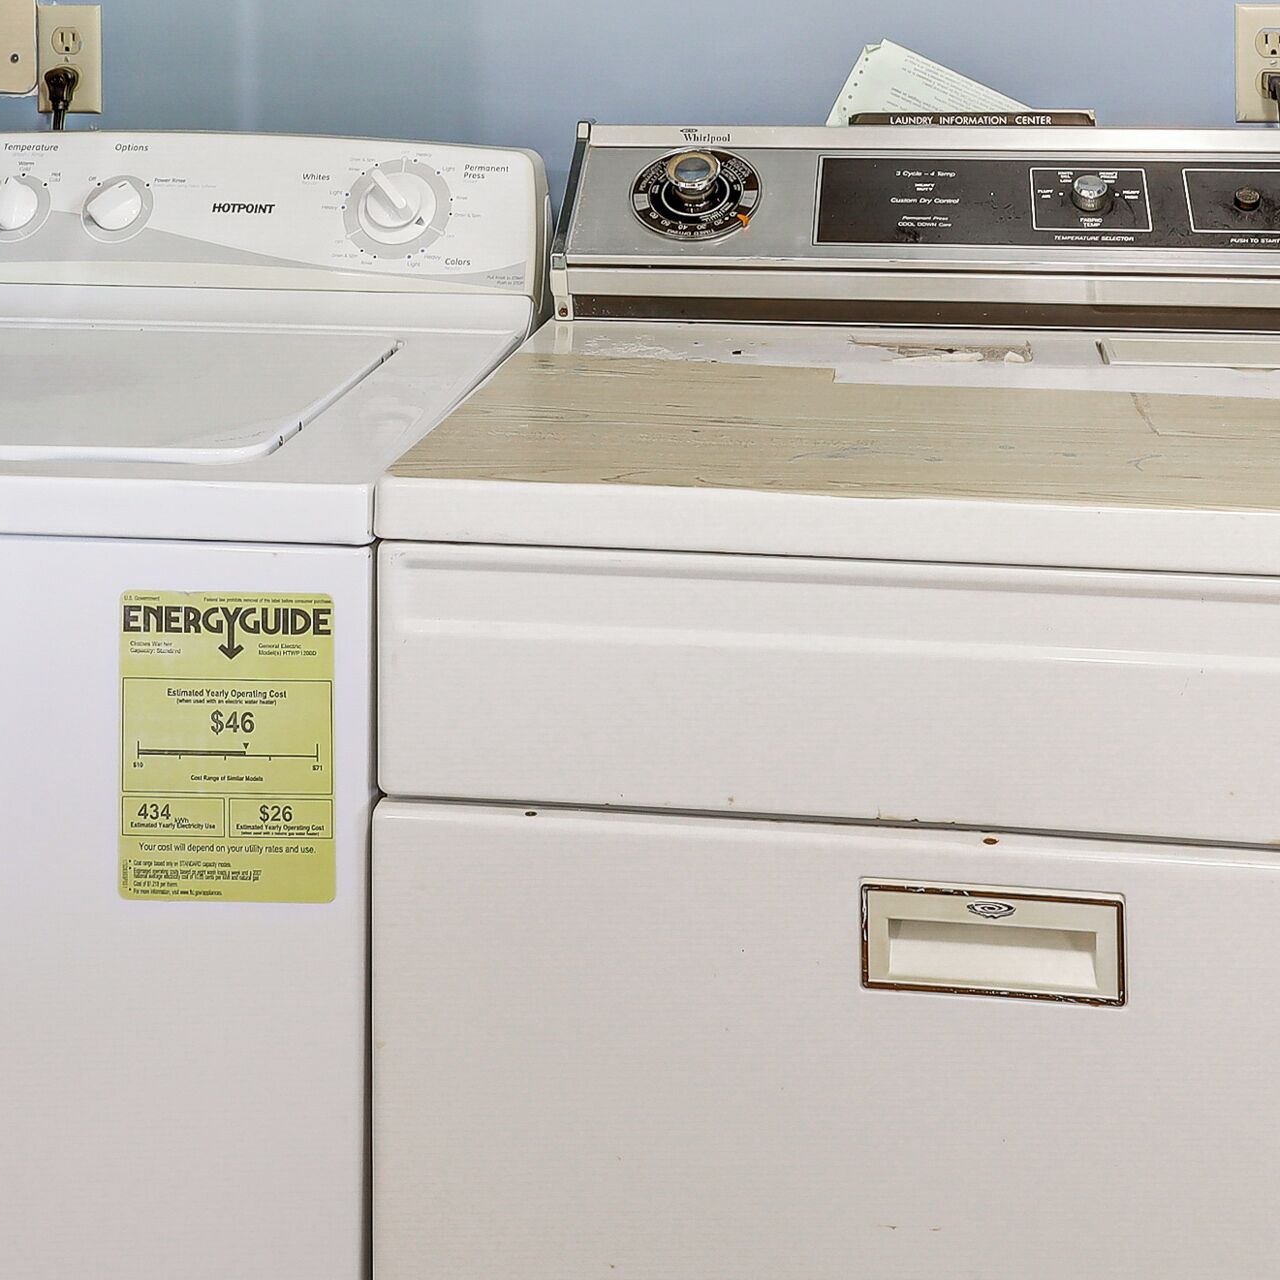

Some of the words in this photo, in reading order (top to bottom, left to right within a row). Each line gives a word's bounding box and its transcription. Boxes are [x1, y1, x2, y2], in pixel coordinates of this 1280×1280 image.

[890, 116, 933, 125] LAUNDRY
[939, 116, 1007, 125] INFORMATION
[1015, 116, 1052, 125] CENTER
[683, 133, 731, 144] Whirlpool
[4, 143, 59, 152] Temperature
[114, 143, 149, 152] Options
[464, 164, 509, 173] Permanent
[302, 173, 330, 181] Whites
[902, 170, 922, 178] Cycle
[212, 203, 276, 214] HOTPOINT
[445, 258, 471, 266] Colors
[123, 605, 331, 636] ENERGYGUIDE
[167, 688, 204, 697] Estimated
[205, 689, 229, 699] Yearly
[230, 689, 267, 699] Operating
[269, 690, 287, 698] Cost
[210, 709, 255, 735] $46
[138, 803, 172, 820] 434
[259, 804, 293, 823] $26
[130, 821, 158, 829] Estimated
[158, 822, 176, 830] Yearly
[176, 822, 204, 830] Electricity
[283, 824, 310, 832] Operating
[139, 842, 156, 851] Your
[157, 843, 173, 851] cost
[173, 843, 186, 851] will
[187, 843, 214, 853] depend
[227, 846, 243, 854] your
[244, 844, 263, 855] utility
[265, 845, 283, 853] rates
[285, 845, 299, 853] and
[300, 846, 316, 854] use.
